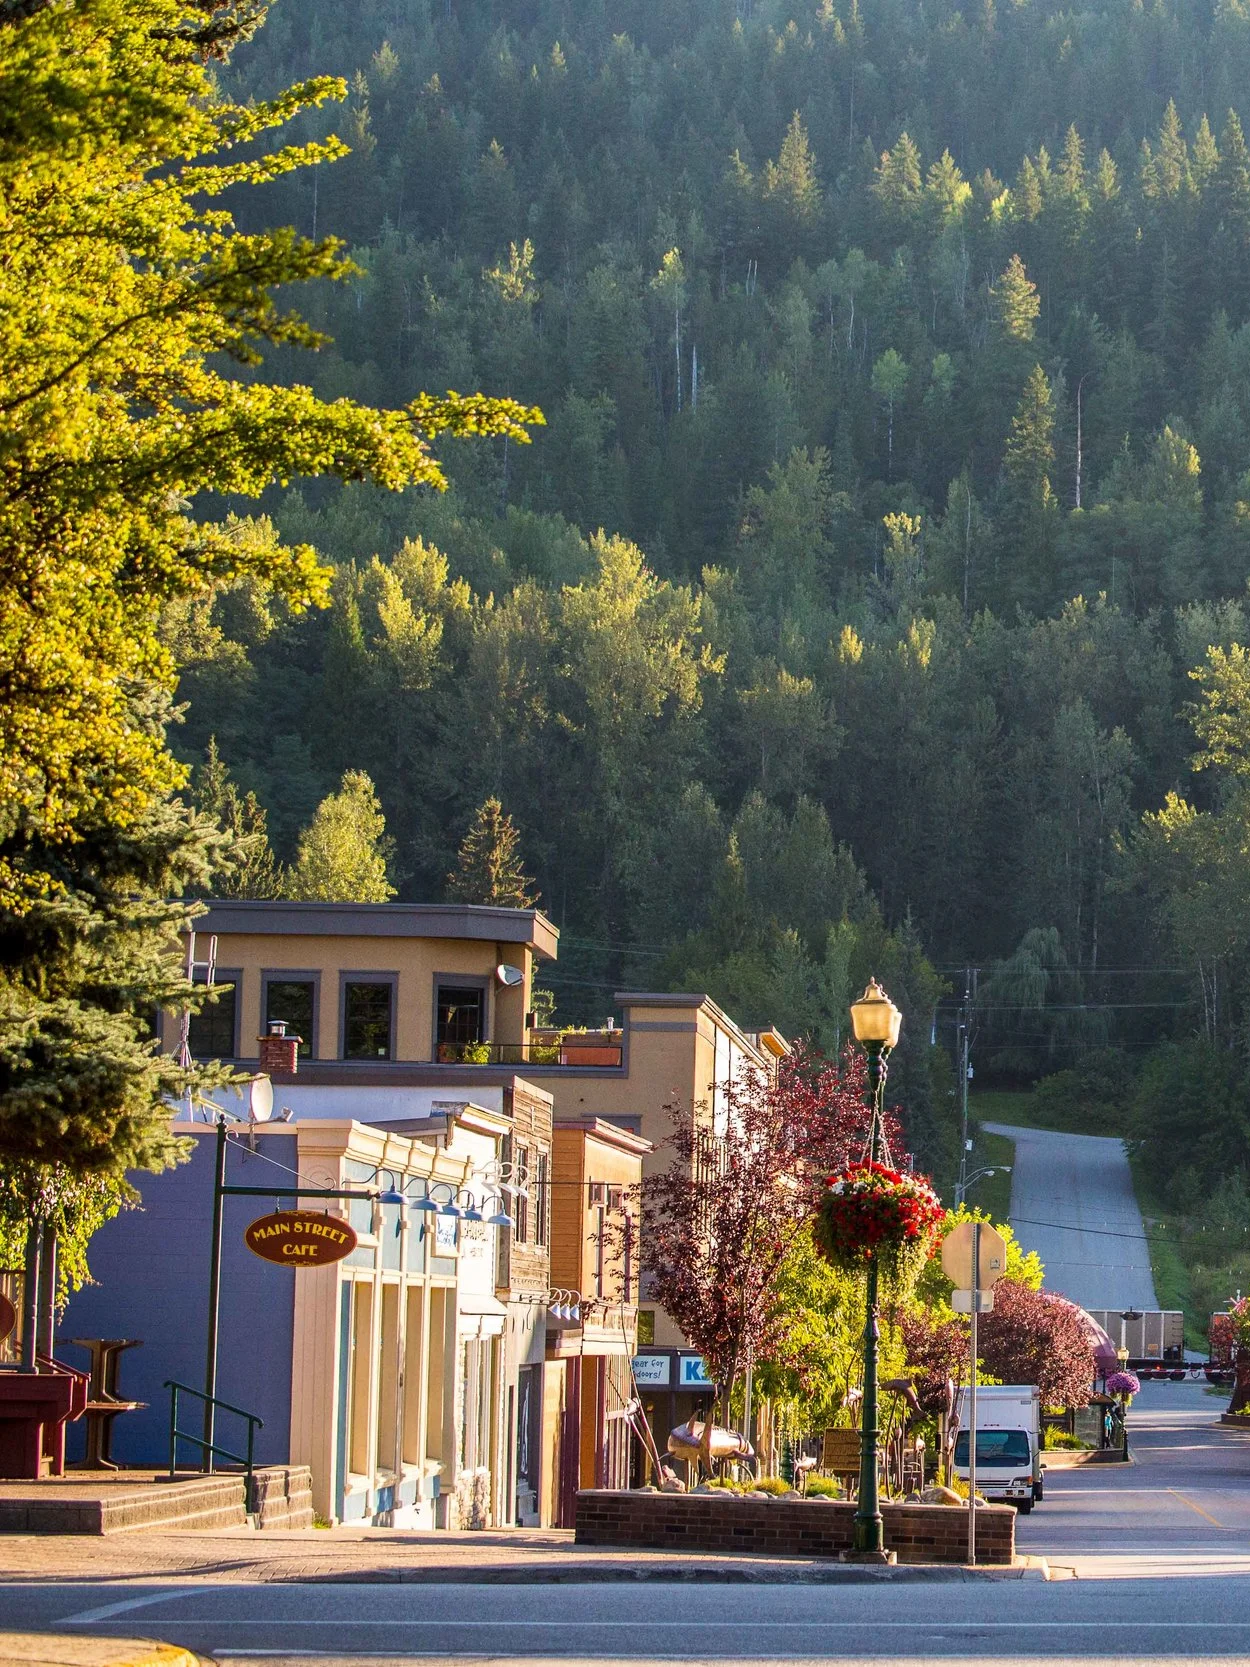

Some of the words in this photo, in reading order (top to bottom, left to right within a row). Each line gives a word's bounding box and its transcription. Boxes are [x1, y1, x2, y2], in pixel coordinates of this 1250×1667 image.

[253, 1222, 290, 1241] MAIN
[293, 1221, 349, 1244] STREET
[282, 1243, 318, 1256] CAFE
[651, 1359, 664, 1368] for
